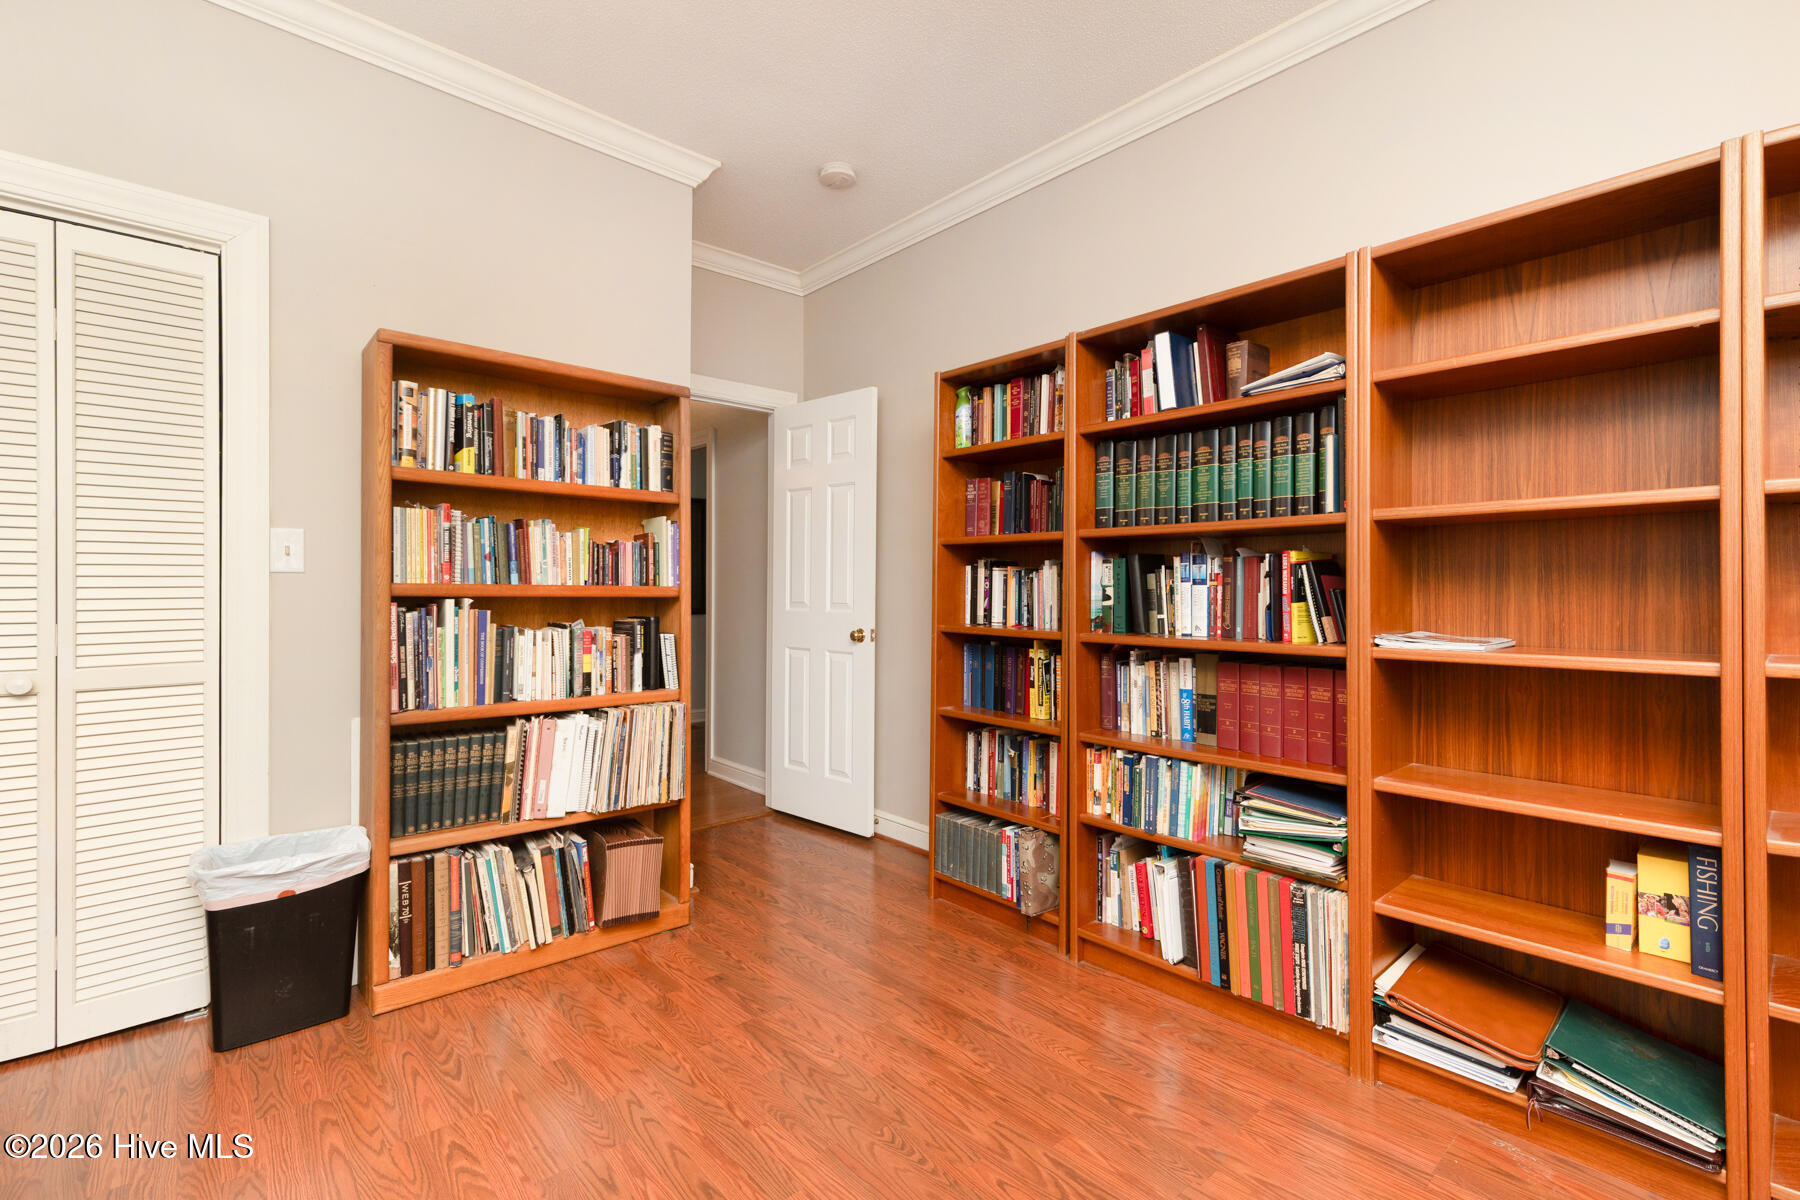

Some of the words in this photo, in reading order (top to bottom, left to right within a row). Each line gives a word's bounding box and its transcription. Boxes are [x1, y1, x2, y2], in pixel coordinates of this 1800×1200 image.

[465, 411, 474, 438] Investing
[1183, 710, 1191, 730] HABIT
[1696, 856, 1719, 933] FISHING
[402, 906, 409, 915] 70
